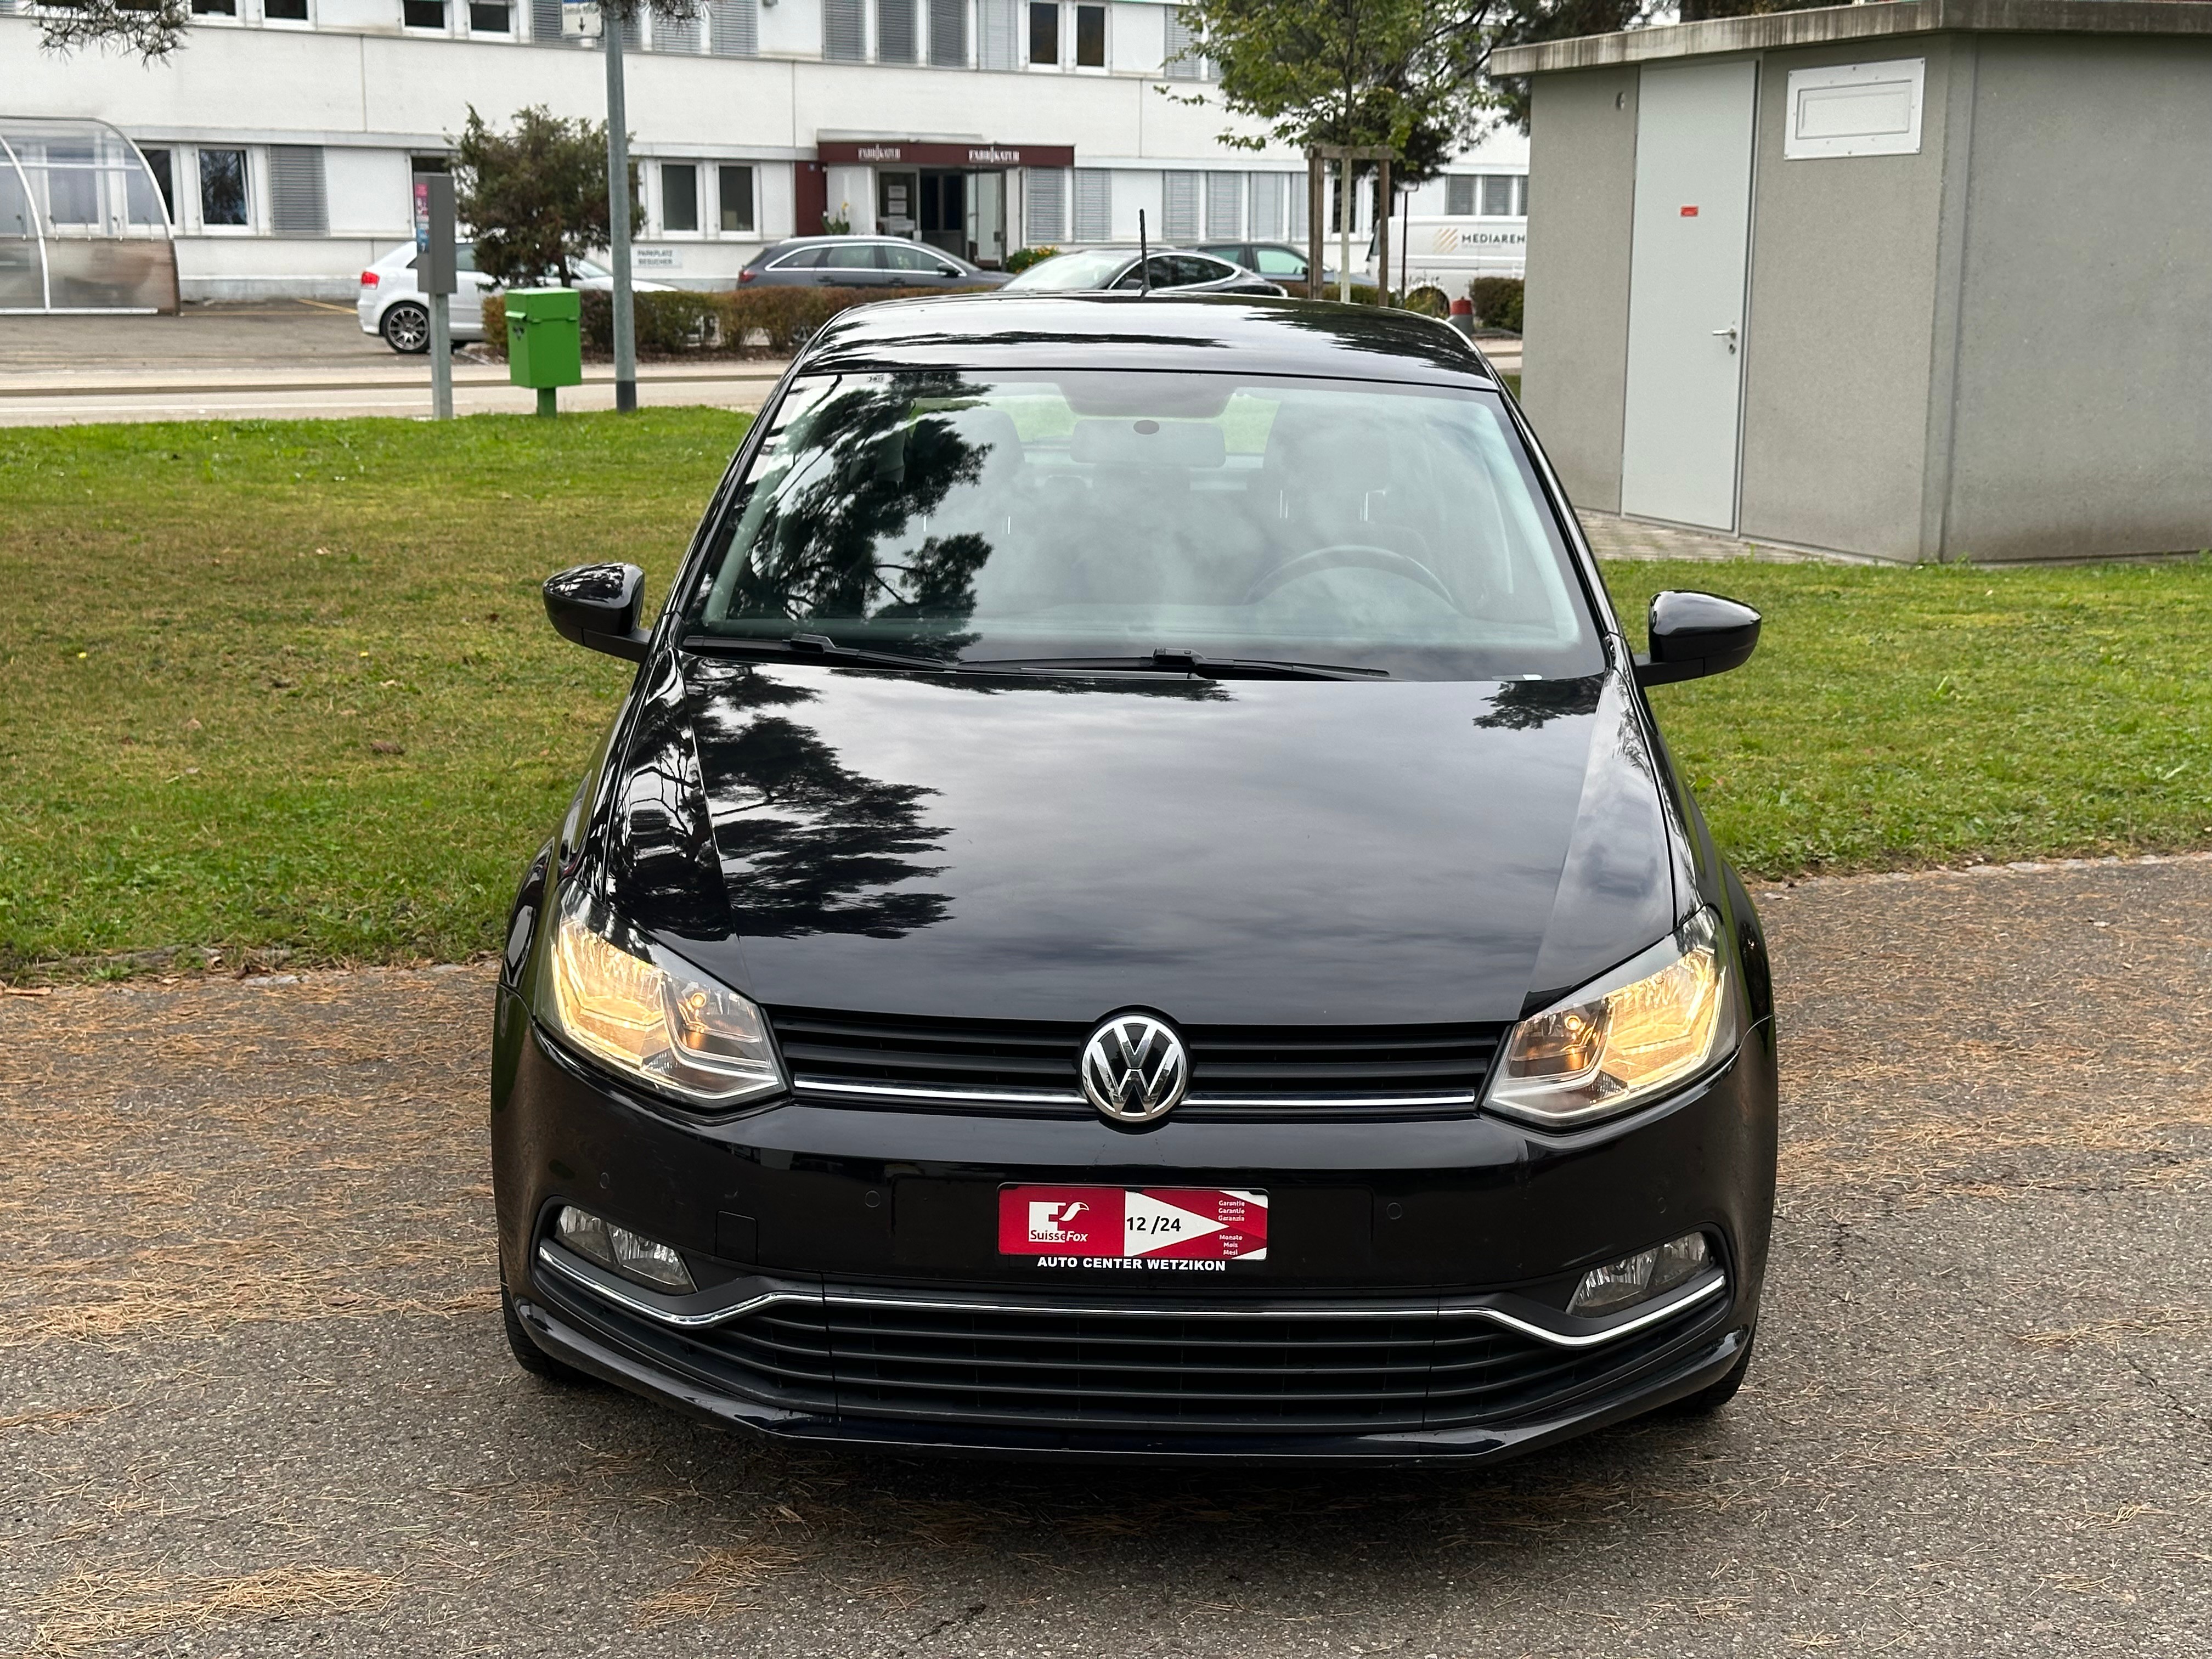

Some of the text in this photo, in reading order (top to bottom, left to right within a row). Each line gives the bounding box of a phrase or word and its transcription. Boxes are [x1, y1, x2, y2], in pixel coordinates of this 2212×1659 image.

[1082, 1015, 1187, 1121] VW
[1030, 1229, 1088, 1242] SuisseFox
[1037, 1256, 1226, 1271] AUTO CENTER WETZIKON
